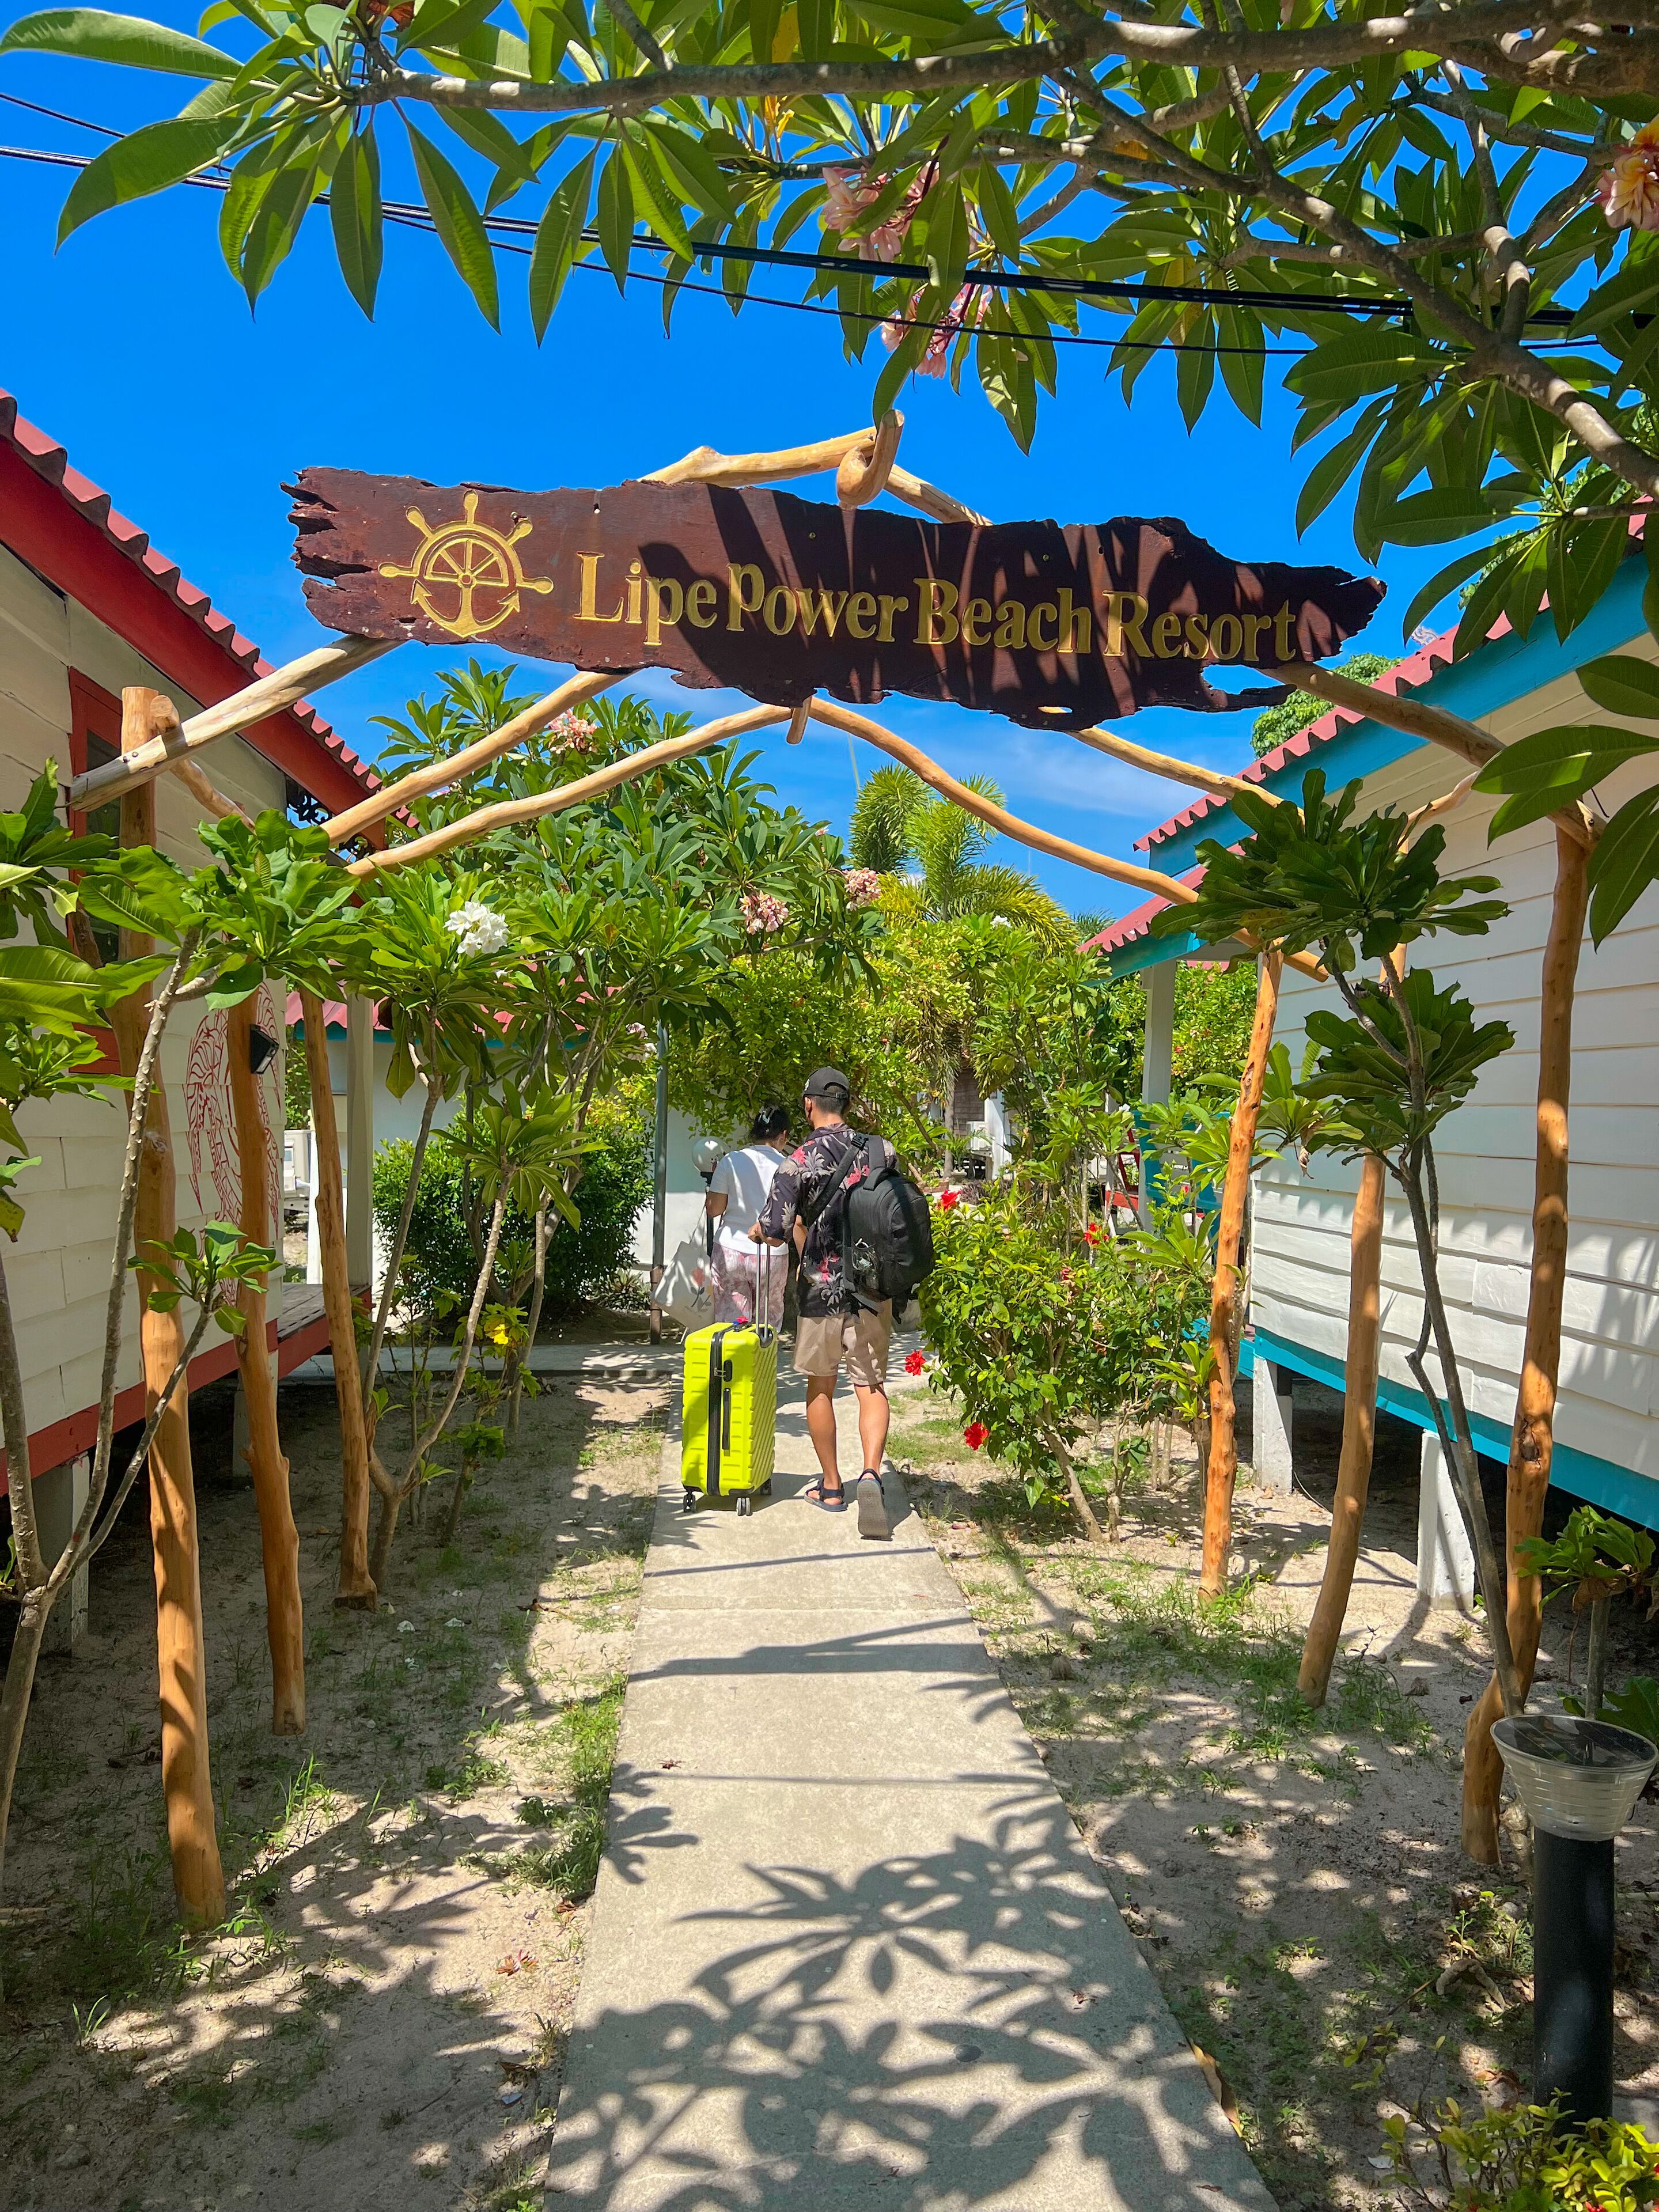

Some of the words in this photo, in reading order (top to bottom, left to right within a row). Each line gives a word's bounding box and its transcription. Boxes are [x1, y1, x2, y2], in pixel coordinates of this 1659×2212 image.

[573, 551, 718, 646] Lipe
[726, 562, 908, 643] Power
[912, 577, 1092, 654] Beach
[1102, 589, 1296, 662] Resort
